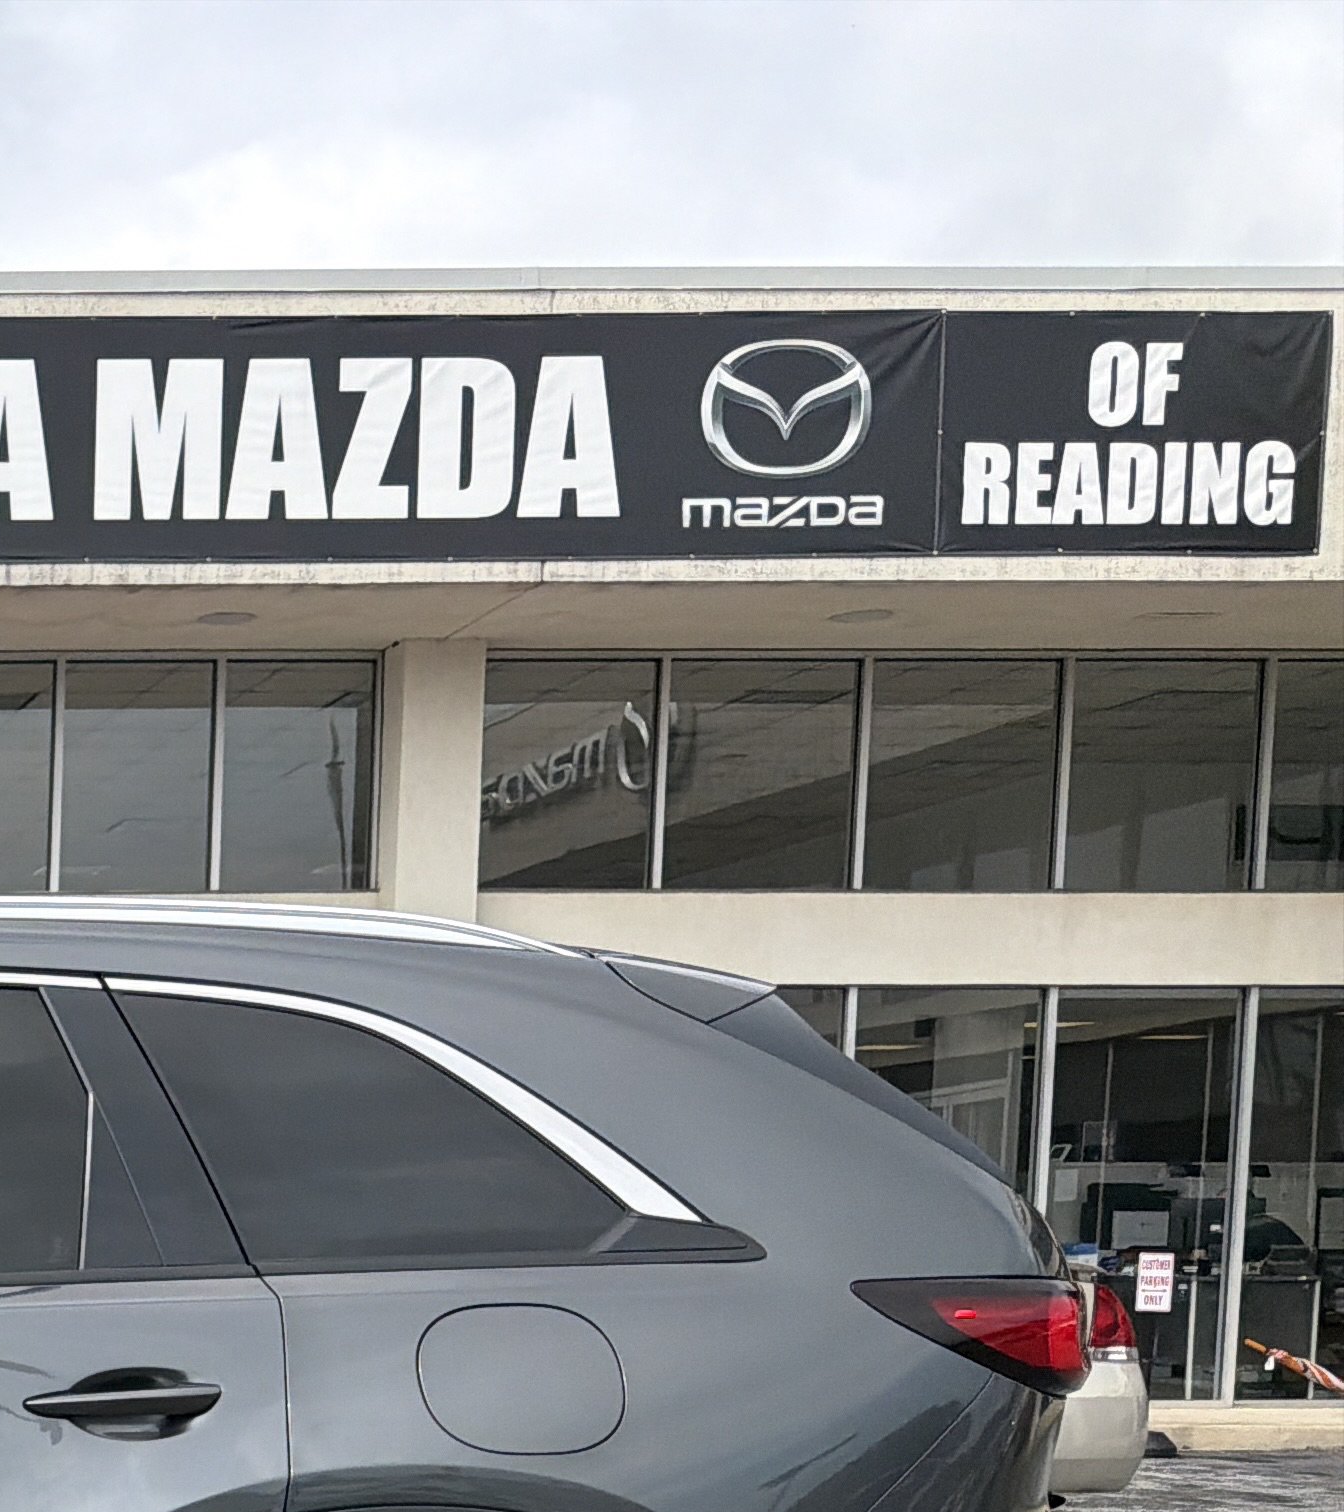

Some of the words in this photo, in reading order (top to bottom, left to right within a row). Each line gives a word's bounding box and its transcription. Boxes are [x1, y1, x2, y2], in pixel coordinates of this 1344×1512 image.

[1087, 340, 1184, 428] OF
[93, 355, 621, 521] MAZDA
[960, 440, 1297, 527] READING
[682, 495, 884, 528] mazda
[1141, 1259, 1171, 1271] CUSTOMER
[1140, 1276, 1170, 1288] PARKING
[1143, 1295, 1164, 1306] ONLY
